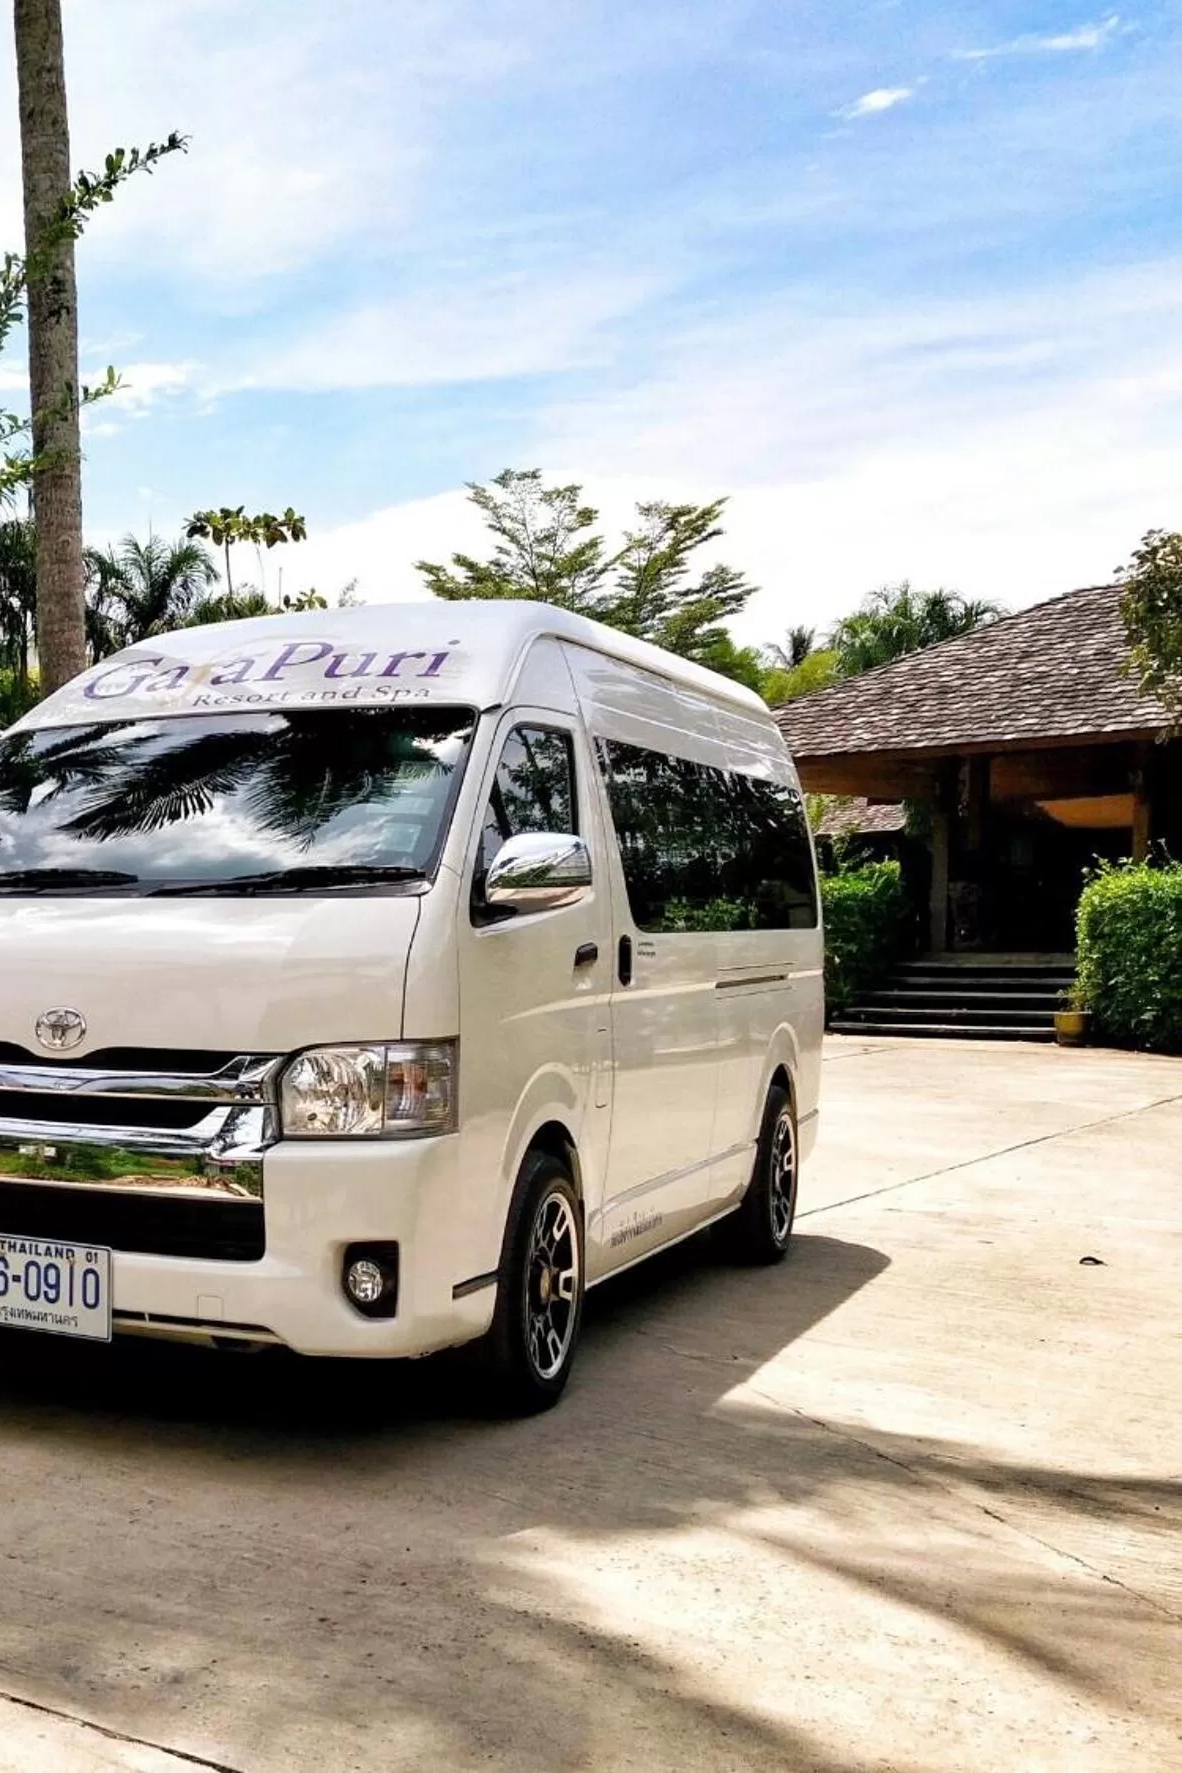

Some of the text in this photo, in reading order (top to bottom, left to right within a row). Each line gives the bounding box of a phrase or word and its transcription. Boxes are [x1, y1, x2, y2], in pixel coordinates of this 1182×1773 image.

[82, 639, 461, 704] GajaPuri
[192, 685, 431, 707] Resort and Spa
[85, 1251, 99, 1264] 01
